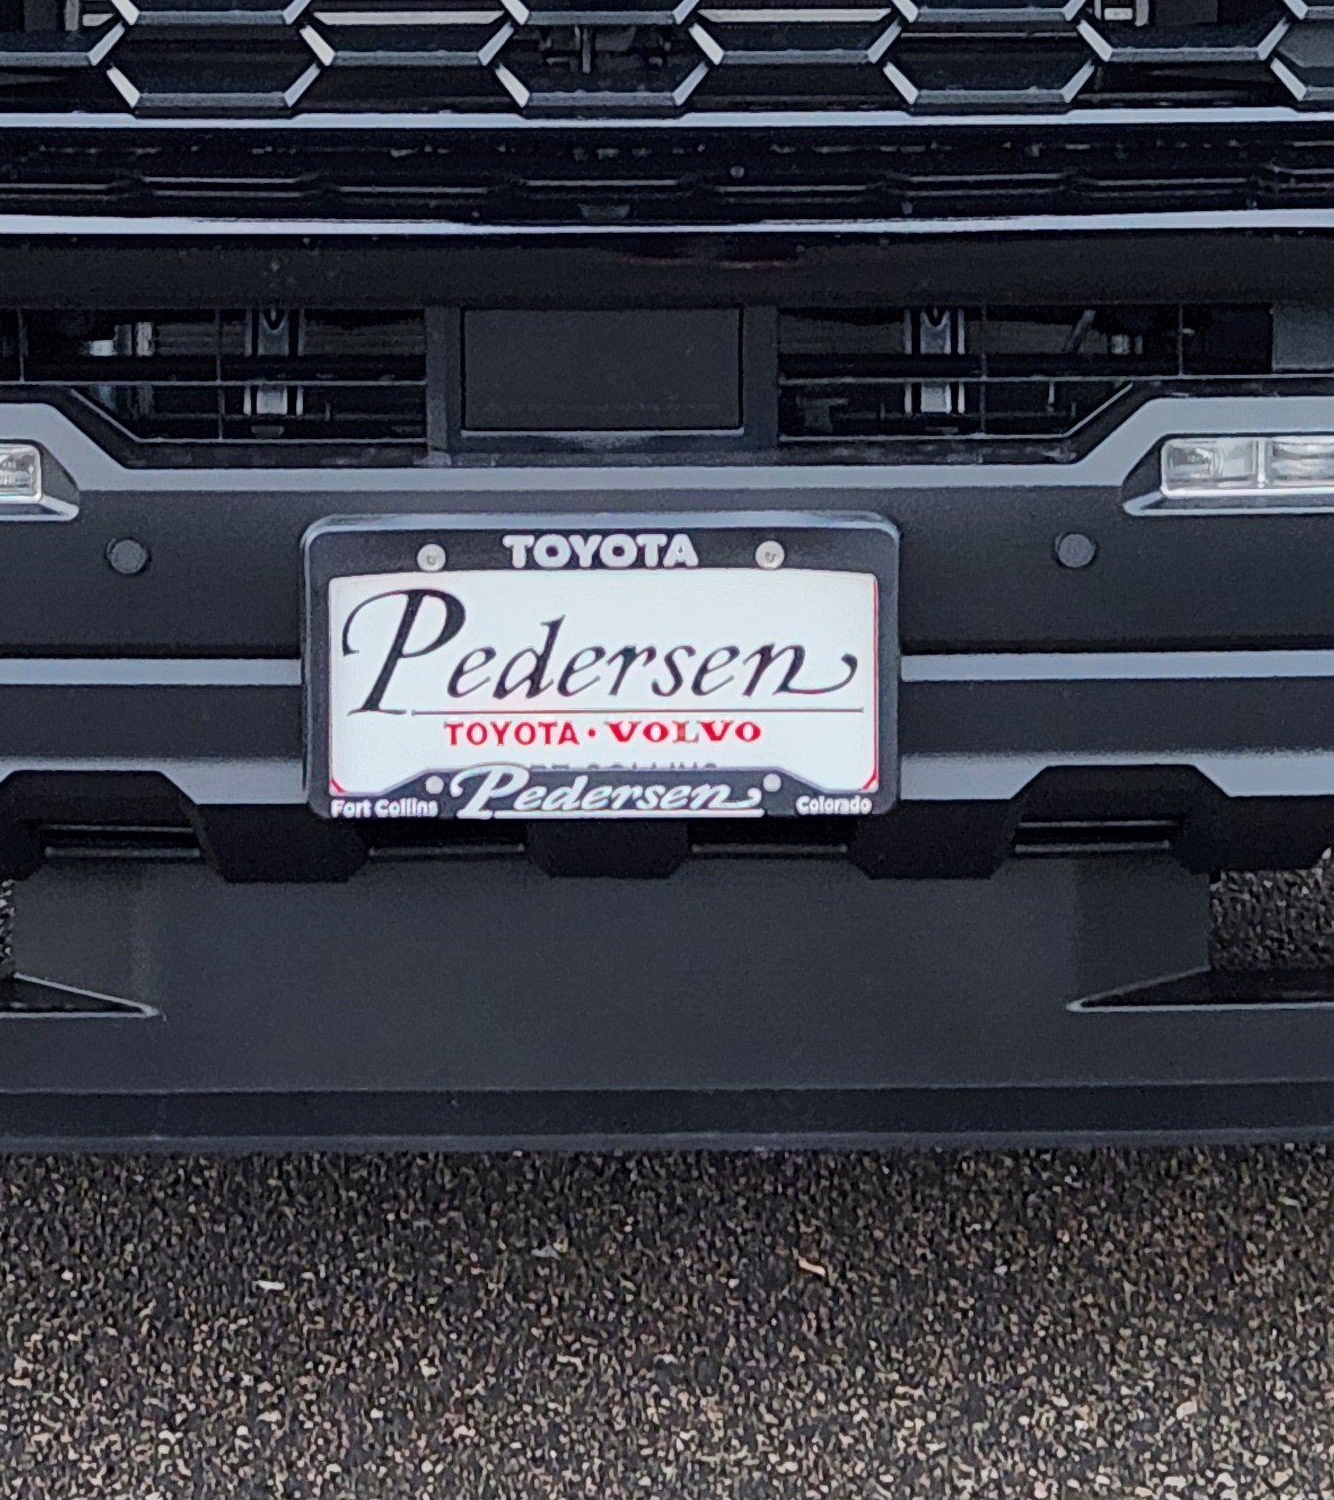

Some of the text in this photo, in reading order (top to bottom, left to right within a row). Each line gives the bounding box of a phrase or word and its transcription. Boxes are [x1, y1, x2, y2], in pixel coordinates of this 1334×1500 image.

[502, 534, 698, 568] TOYOTA
[342, 588, 857, 717] Pedersen
[444, 720, 761, 746] TOYOTA VOLVO
[450, 763, 763, 819] Pedersen
[795, 795, 873, 816] Colorado
[331, 798, 439, 819] Fort Collins
